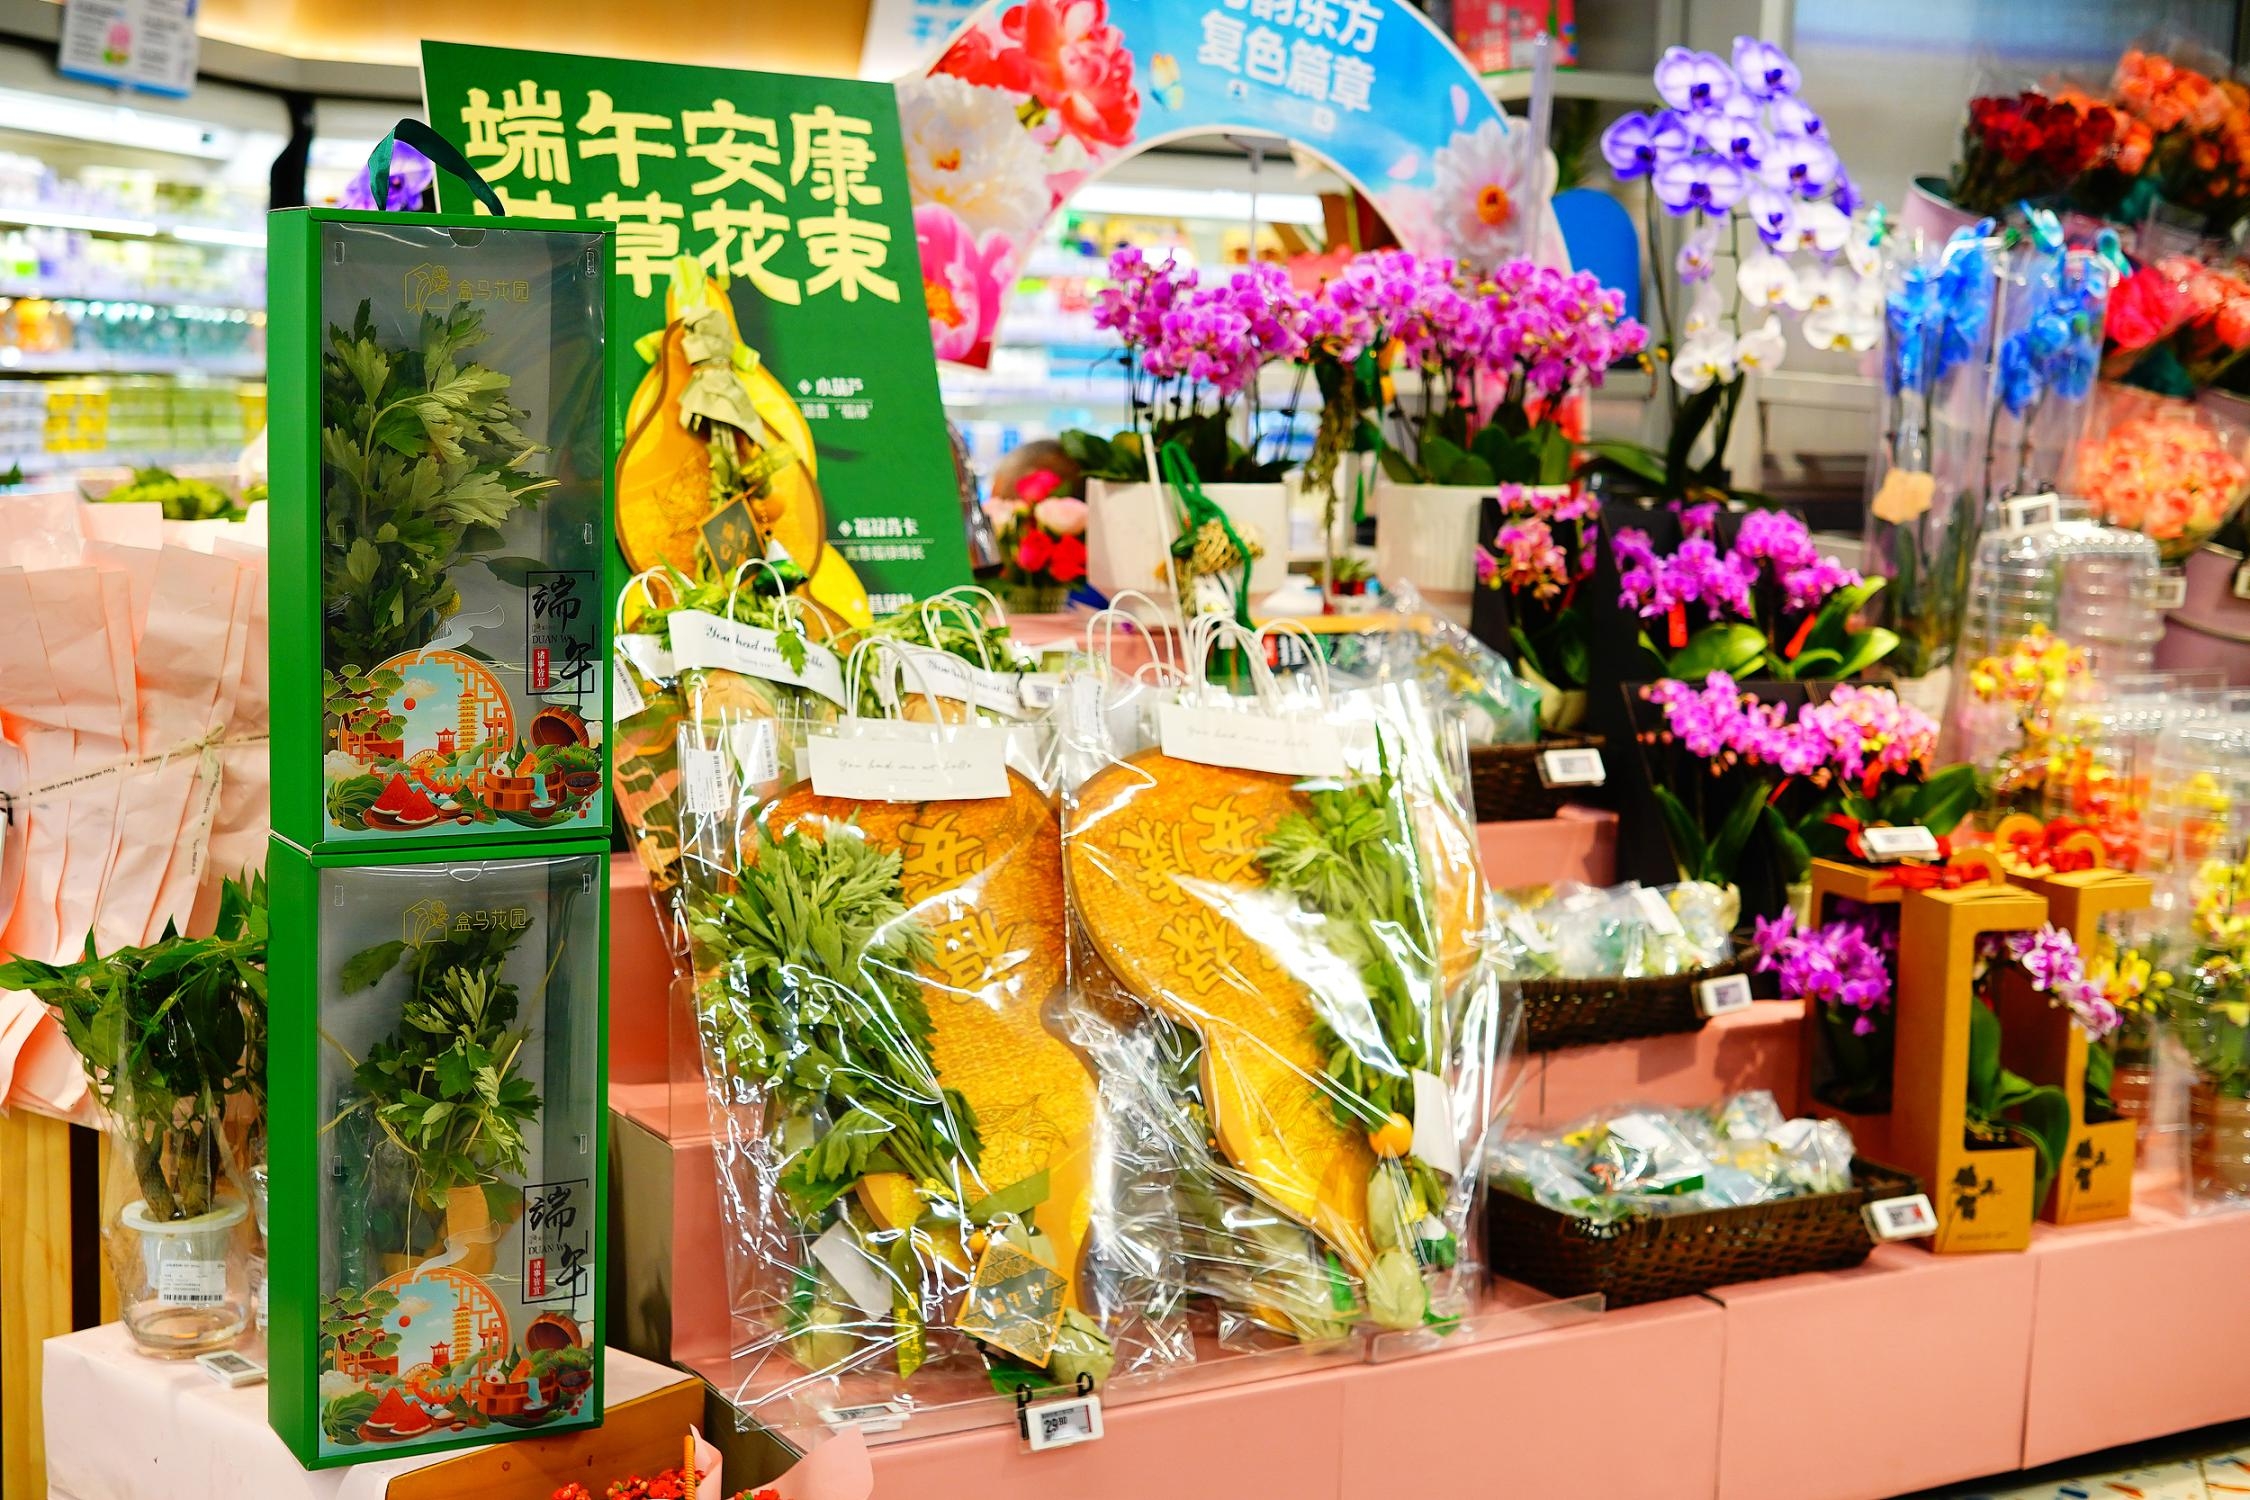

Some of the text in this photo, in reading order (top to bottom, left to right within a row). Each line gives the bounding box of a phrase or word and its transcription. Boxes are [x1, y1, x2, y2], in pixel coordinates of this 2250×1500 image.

[1197, 9, 1376, 112] 复色篇章
[461, 80, 883, 207] 端午安康
[456, 279, 529, 304] 盒马花园
[531, 574, 594, 717] 端午
[532, 634, 558, 644] DUAN
[735, 634, 760, 650] had
[454, 908, 527, 932] 盒马花园
[528, 1185, 587, 1314] 端午
